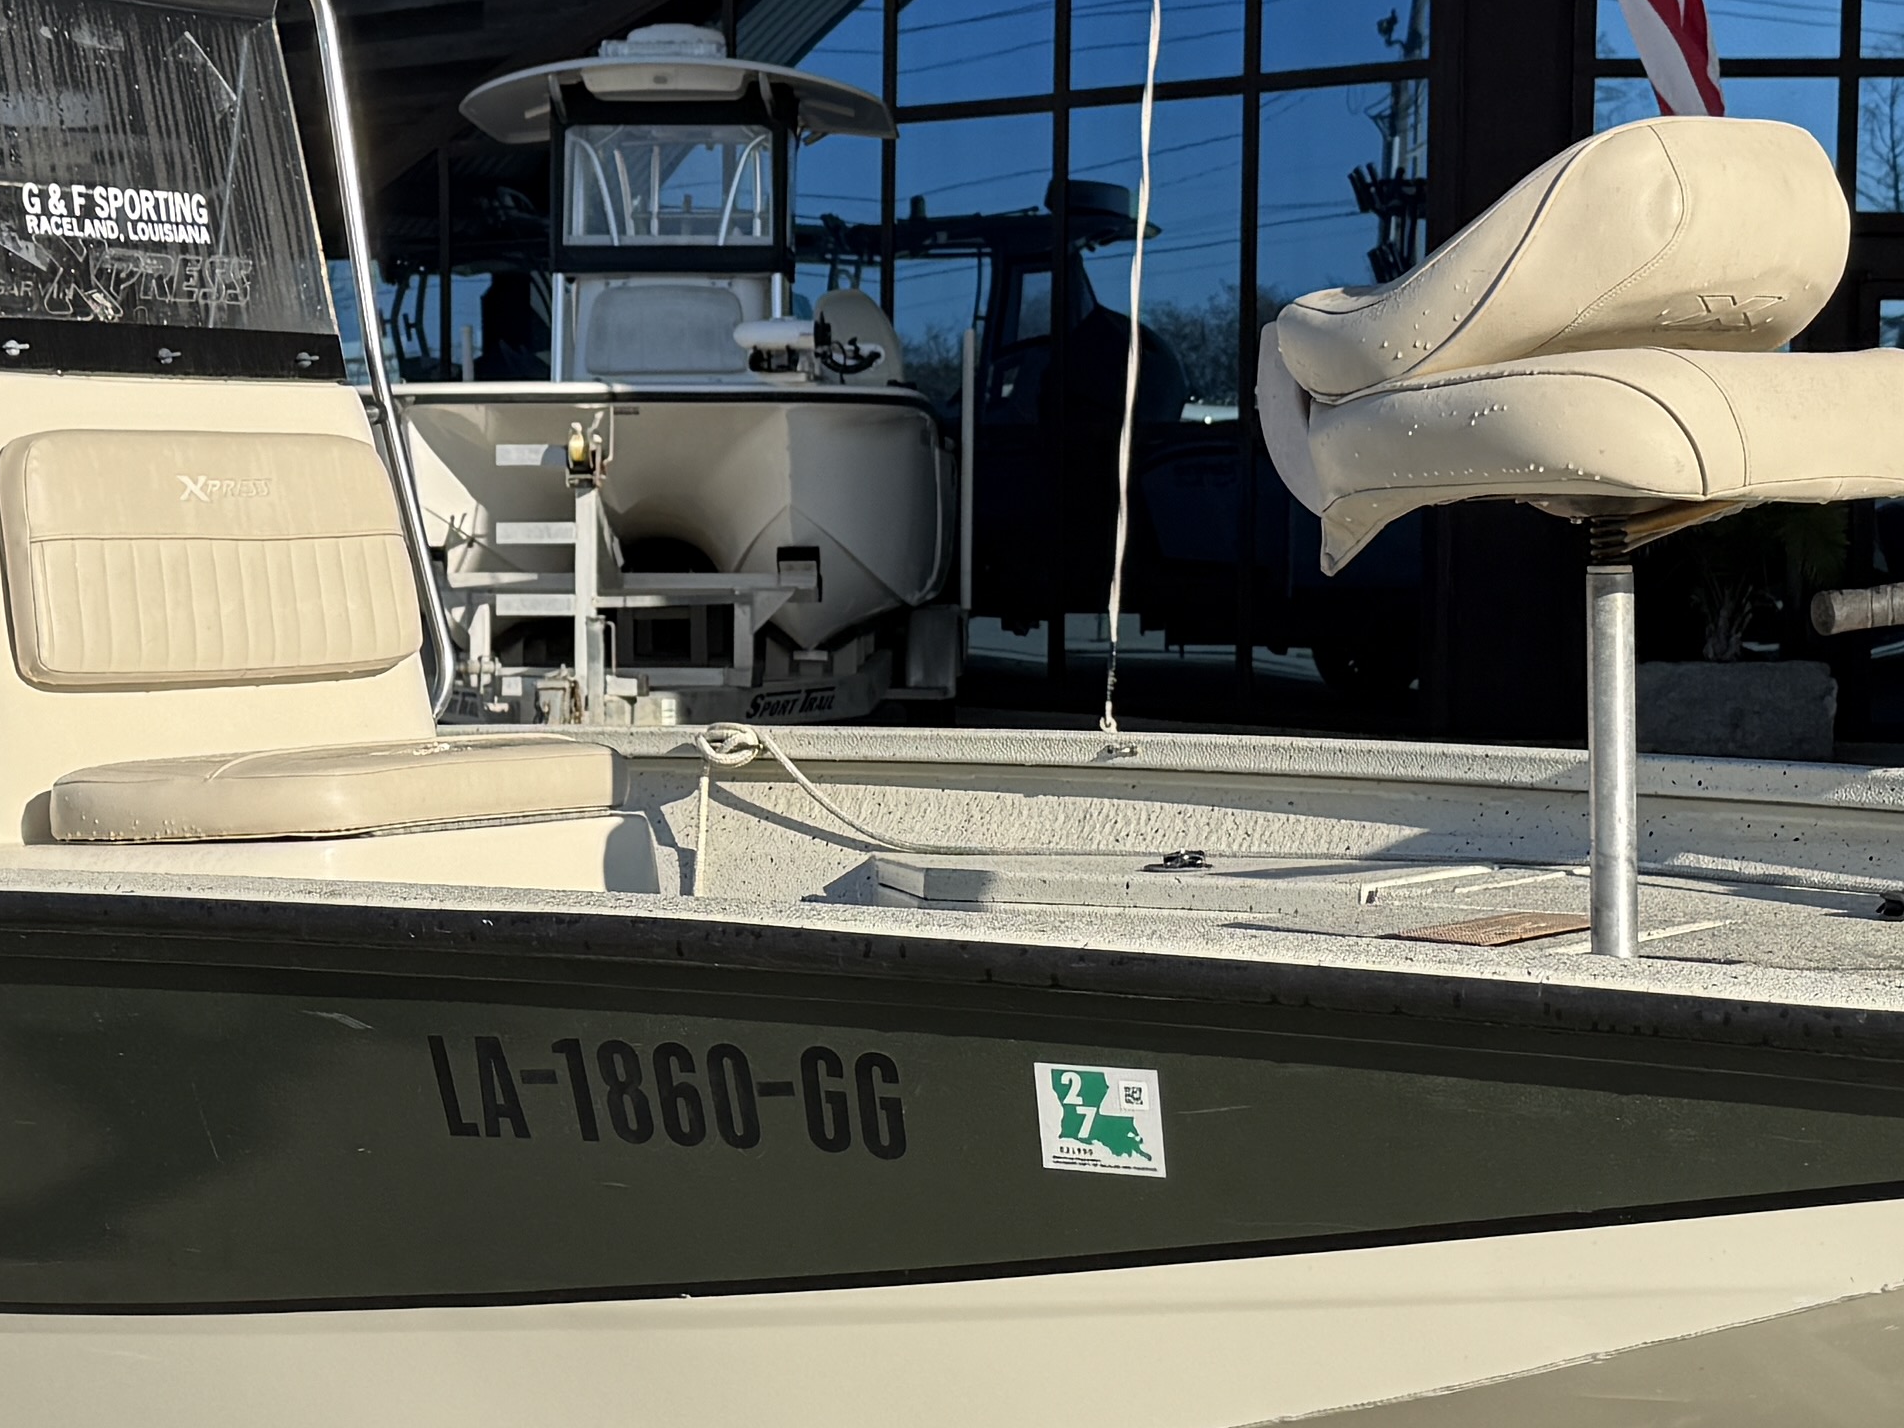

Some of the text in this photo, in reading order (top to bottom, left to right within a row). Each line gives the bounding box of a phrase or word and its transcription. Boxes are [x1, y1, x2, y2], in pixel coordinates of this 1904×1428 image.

[21, 181, 209, 225] G & F SPORTING
[25, 214, 211, 245] RACELAND, LOUISIANA
[32, 232, 253, 321] XPRESS
[176, 473, 273, 503] XPRESS
[746, 690, 802, 719] SPORT
[425, 1034, 906, 1161] LA-1860-GG
[1060, 1071, 1084, 1105] 2
[1075, 1105, 1097, 1139] 7
